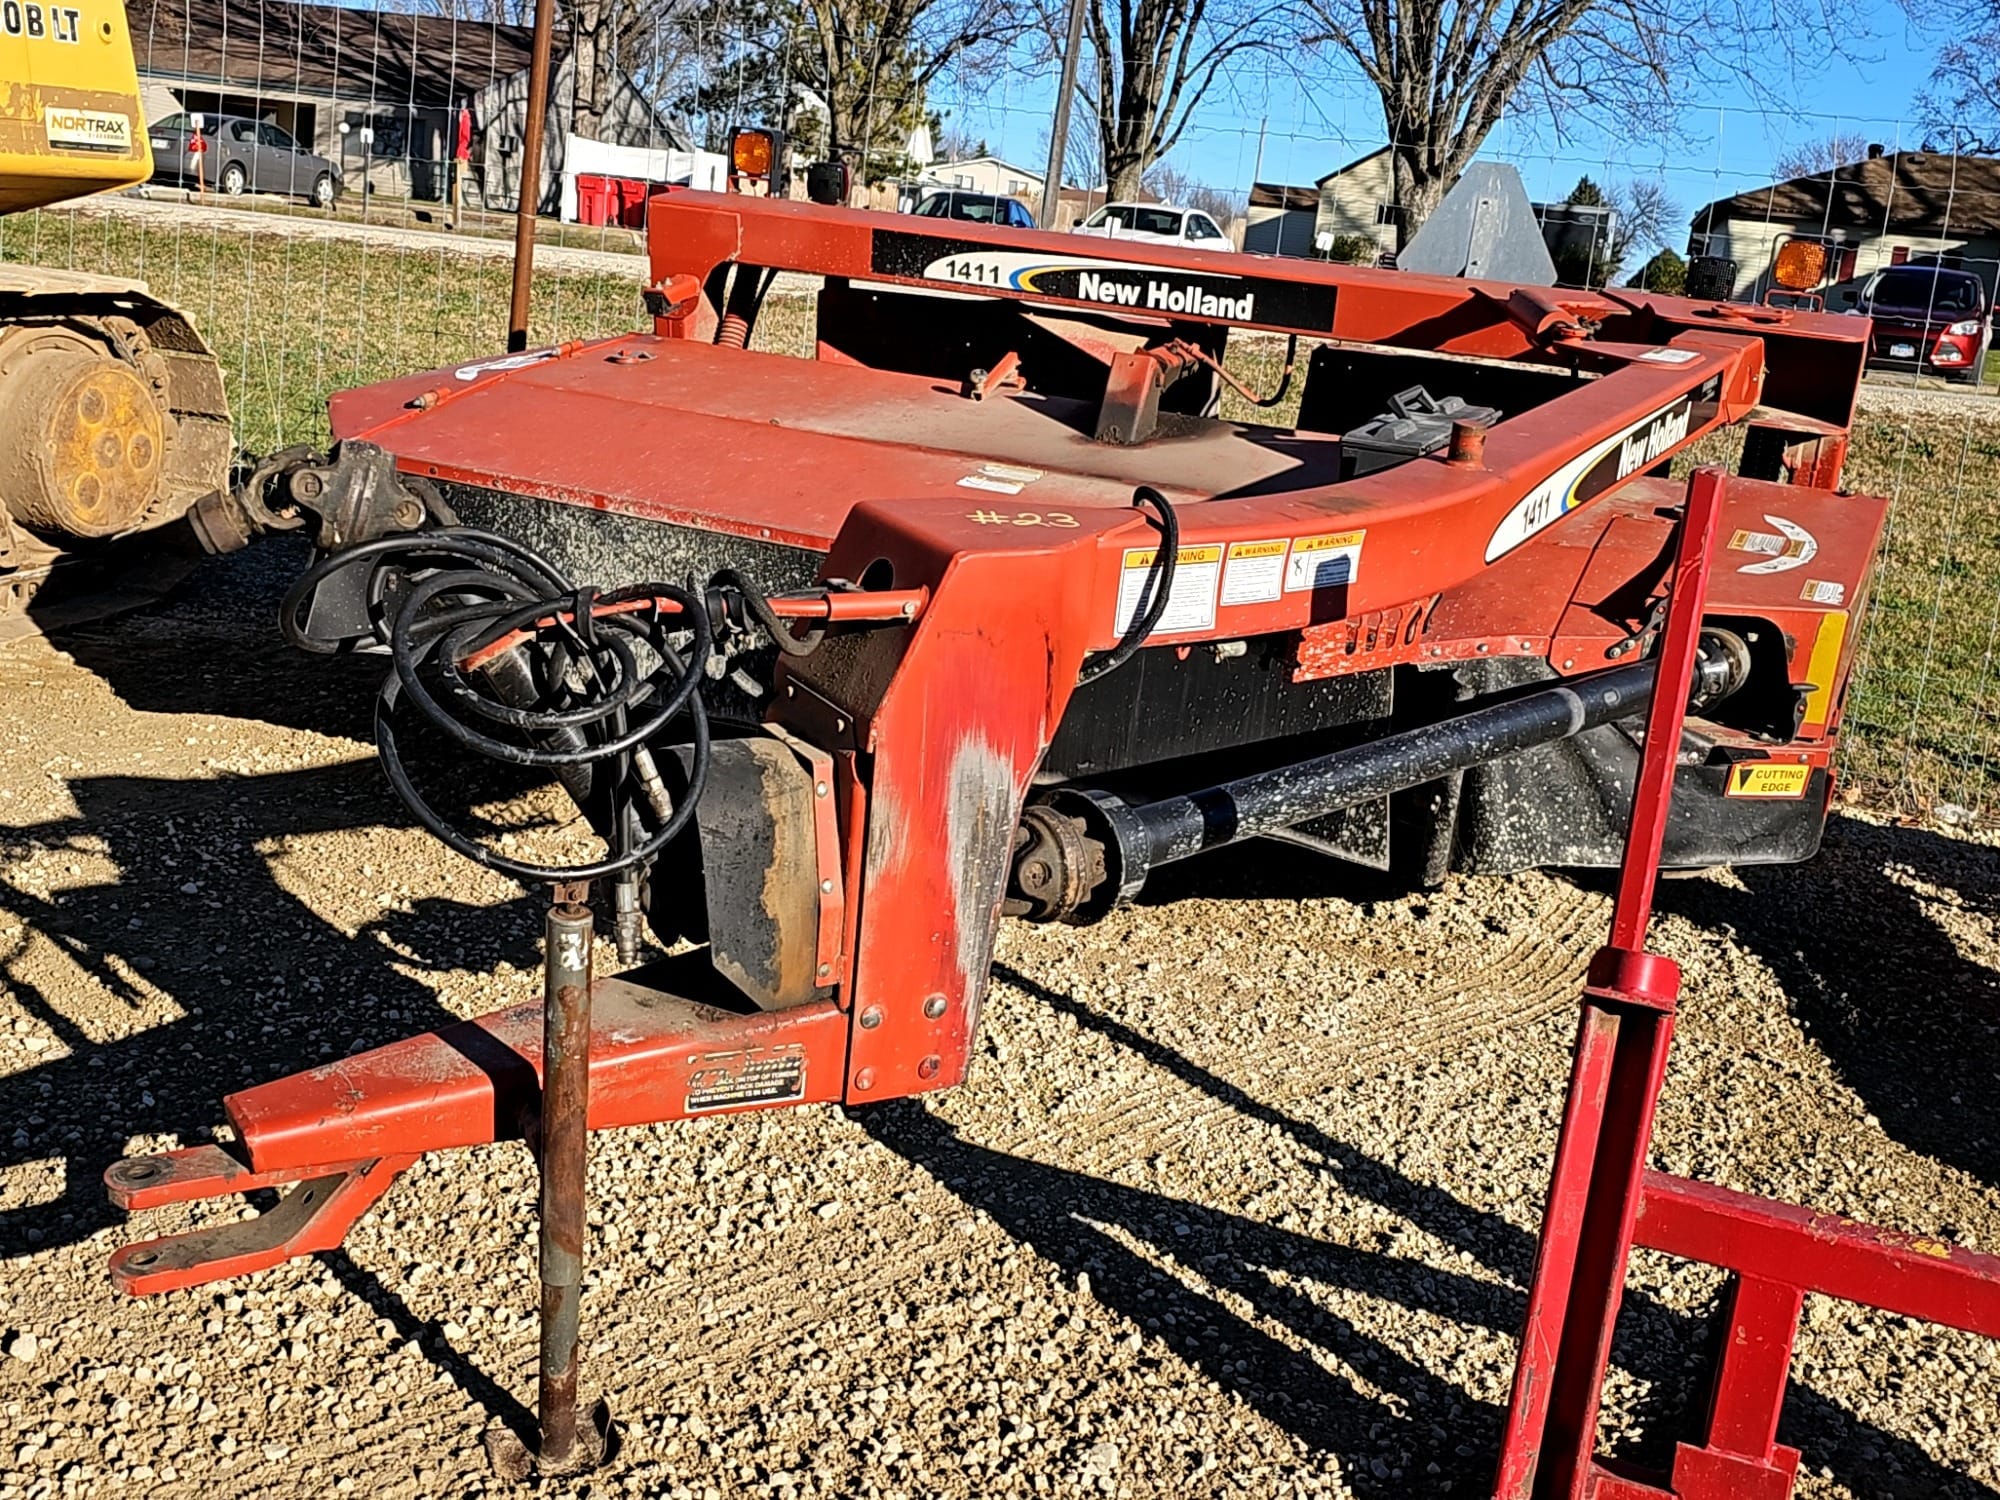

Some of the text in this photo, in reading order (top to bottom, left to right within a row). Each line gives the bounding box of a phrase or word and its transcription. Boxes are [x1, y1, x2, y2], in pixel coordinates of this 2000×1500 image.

[51, 8, 79, 42] LT
[52, 114, 125, 135] NORTRAX
[946, 259, 1000, 284] 1411
[1078, 272, 1255, 321] New Holland
[1616, 401, 1693, 480] New Holland
[1523, 490, 1551, 533] 1411
[1244, 545, 1281, 556] WARNING
[1317, 535, 1354, 548] WARNING
[1755, 770, 1804, 780] CUTTING
[1760, 783, 1792, 792] EDGE
